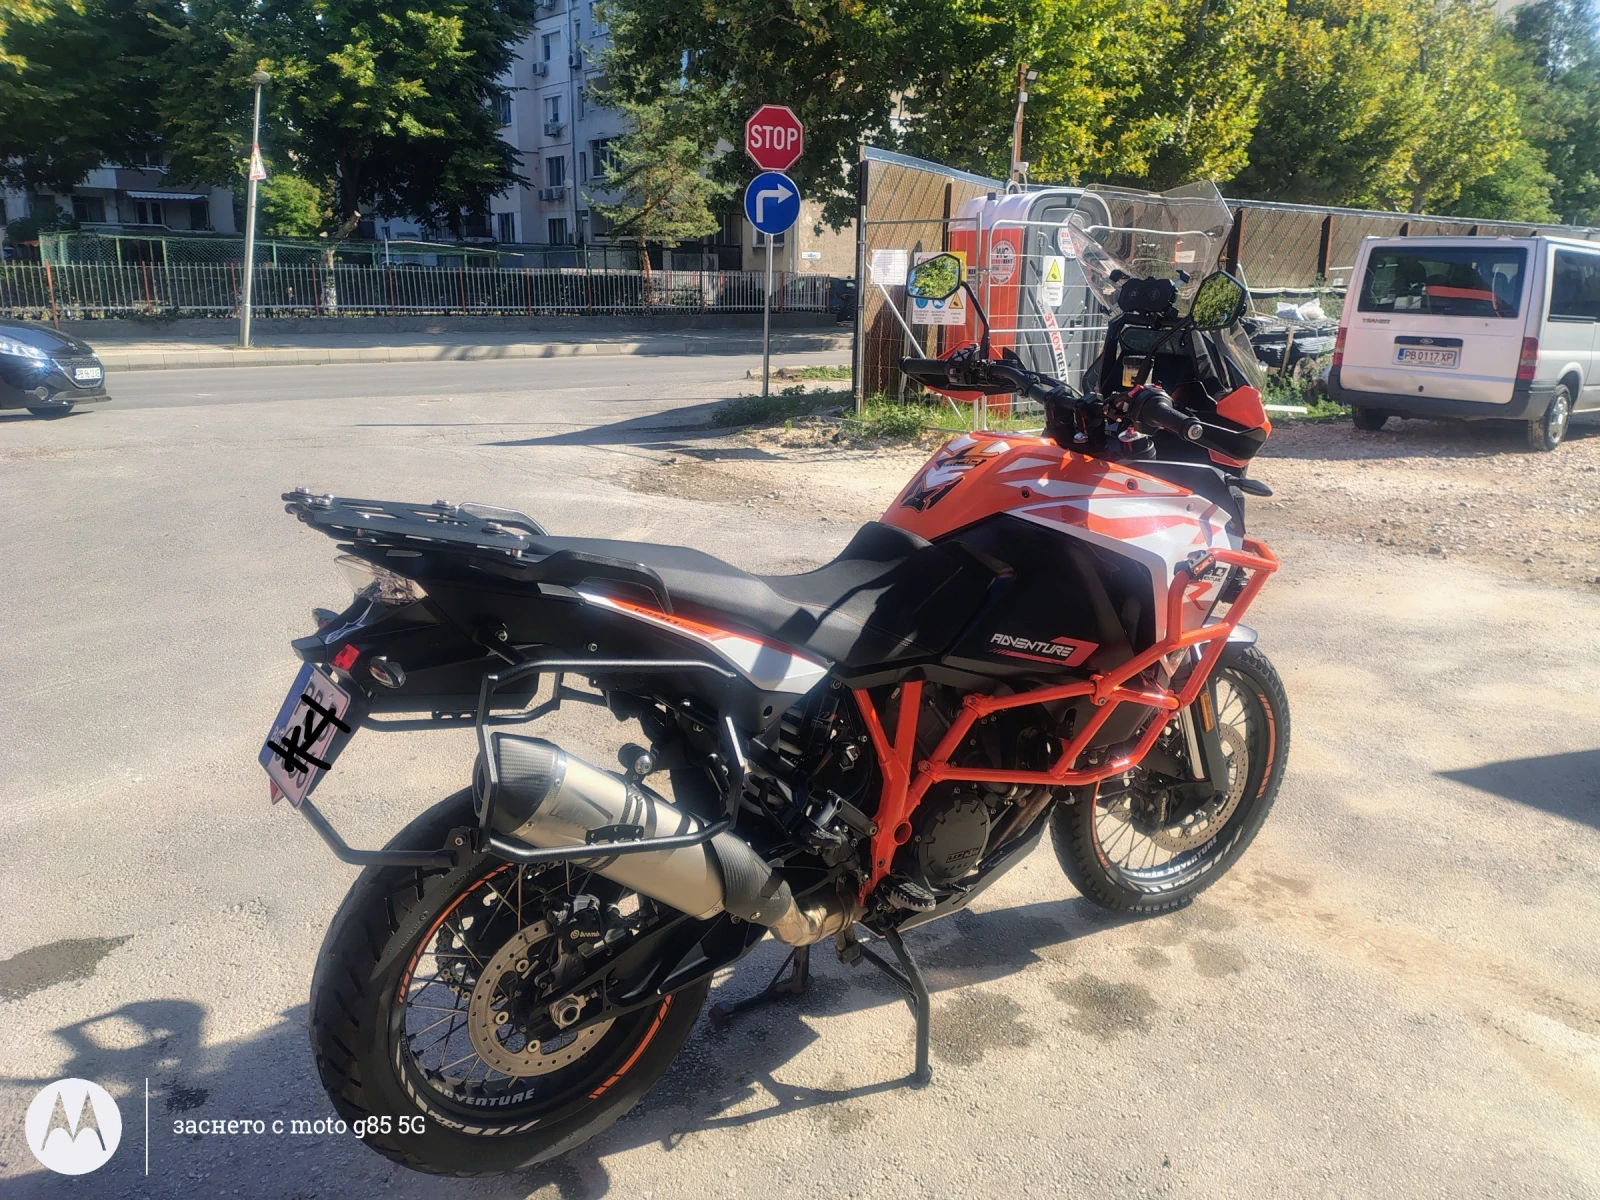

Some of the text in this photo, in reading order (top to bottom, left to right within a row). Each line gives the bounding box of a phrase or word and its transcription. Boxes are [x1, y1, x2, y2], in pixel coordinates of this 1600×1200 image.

[751, 125, 798, 150] STOP
[1404, 350, 1454, 362] PB 0117 XP
[990, 633, 1074, 657] ADVENTURE
[580, 930, 601, 938] bremb
[433, 1083, 535, 1106] ADVENTURE
